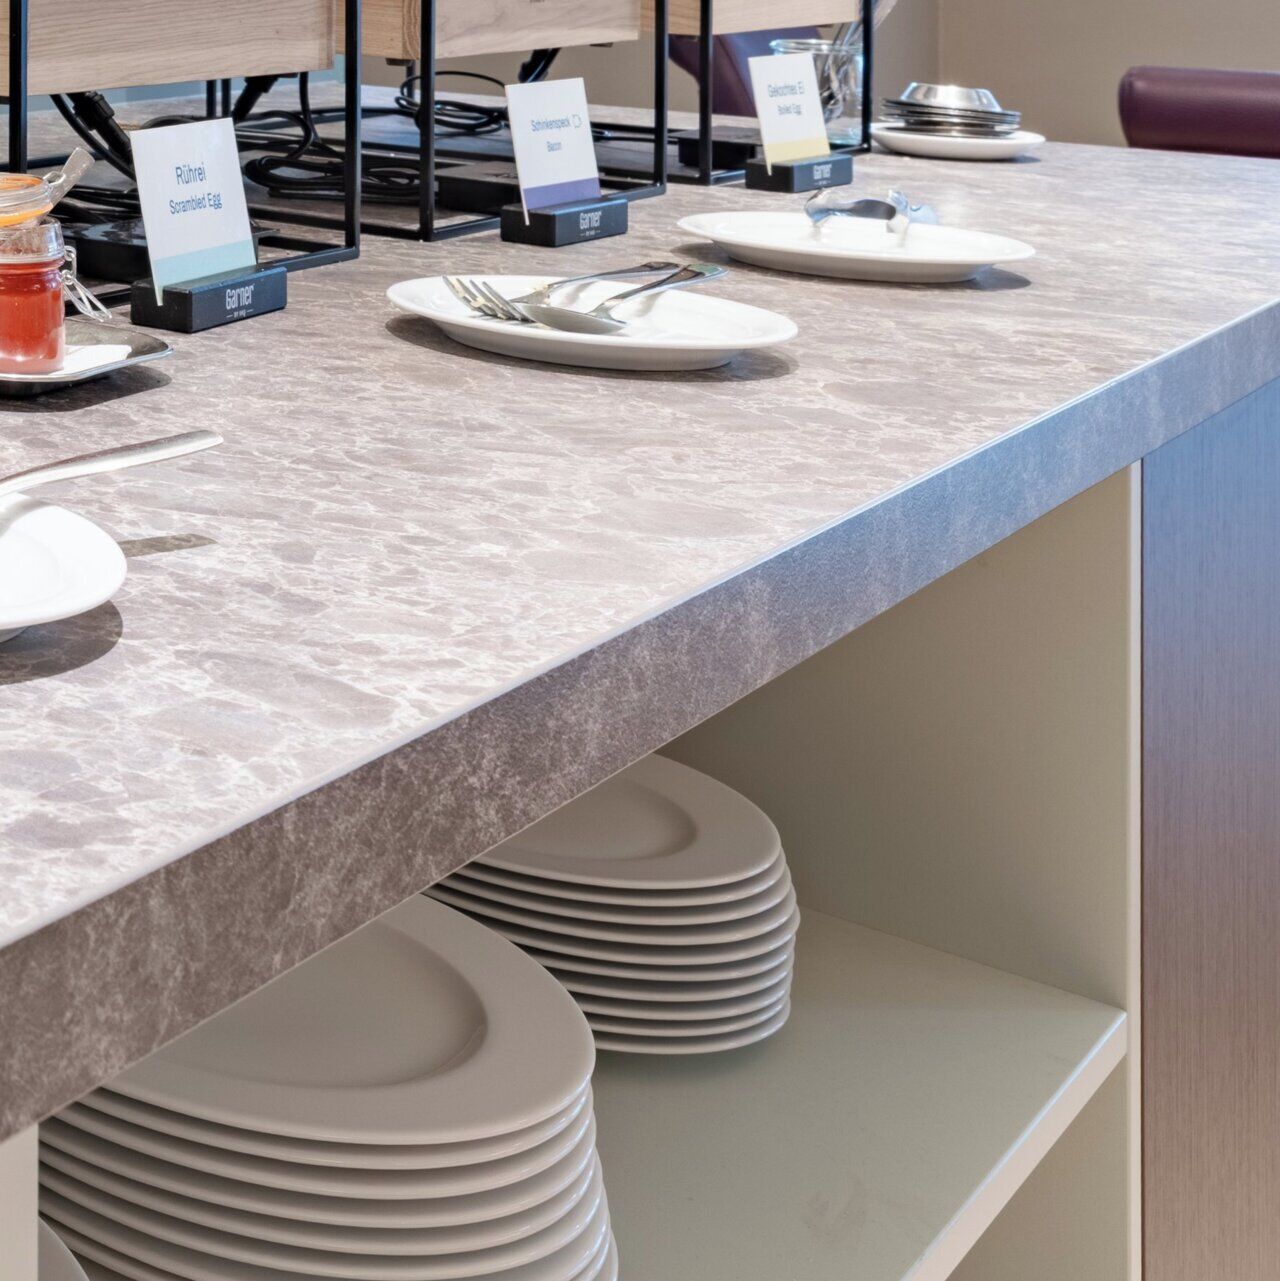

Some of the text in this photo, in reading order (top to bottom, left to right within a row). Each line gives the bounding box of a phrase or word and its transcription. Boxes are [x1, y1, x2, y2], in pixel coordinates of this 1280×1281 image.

[175, 161, 207, 185] Rührei
[169, 192, 223, 215] Scrambled Egg
[226, 285, 254, 310] Garner
